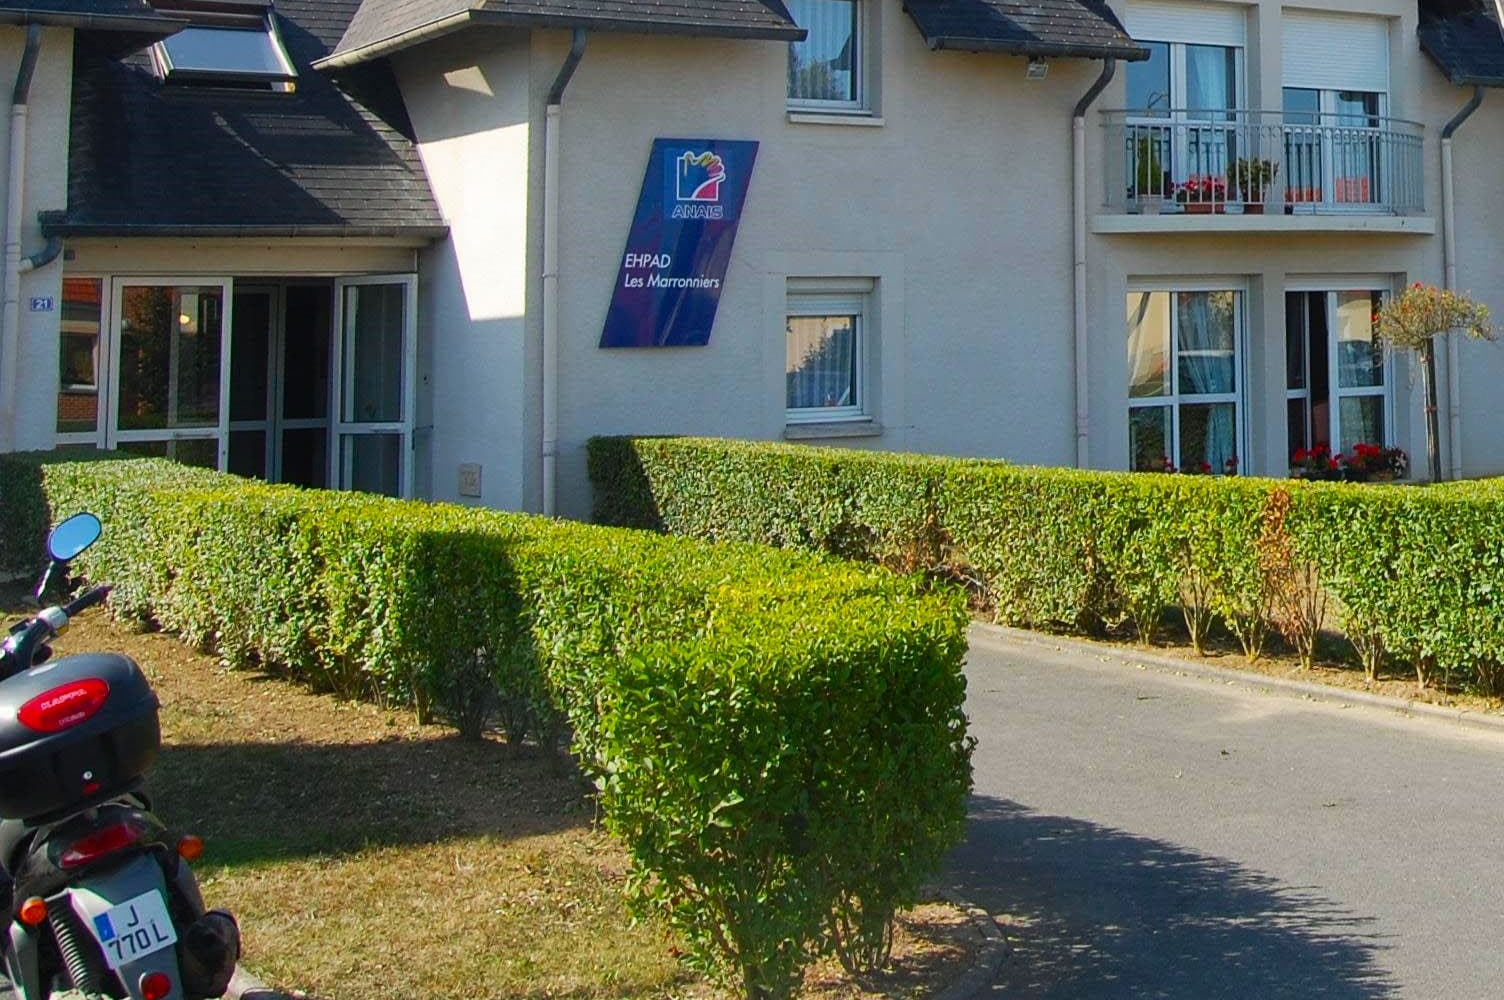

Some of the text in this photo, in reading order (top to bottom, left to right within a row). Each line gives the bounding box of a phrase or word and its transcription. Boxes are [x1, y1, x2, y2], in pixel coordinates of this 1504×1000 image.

[672, 204, 724, 219] ANAIS
[624, 253, 671, 268] EHPAD
[624, 273, 720, 289] Les Marronniers
[127, 904, 140, 928] J
